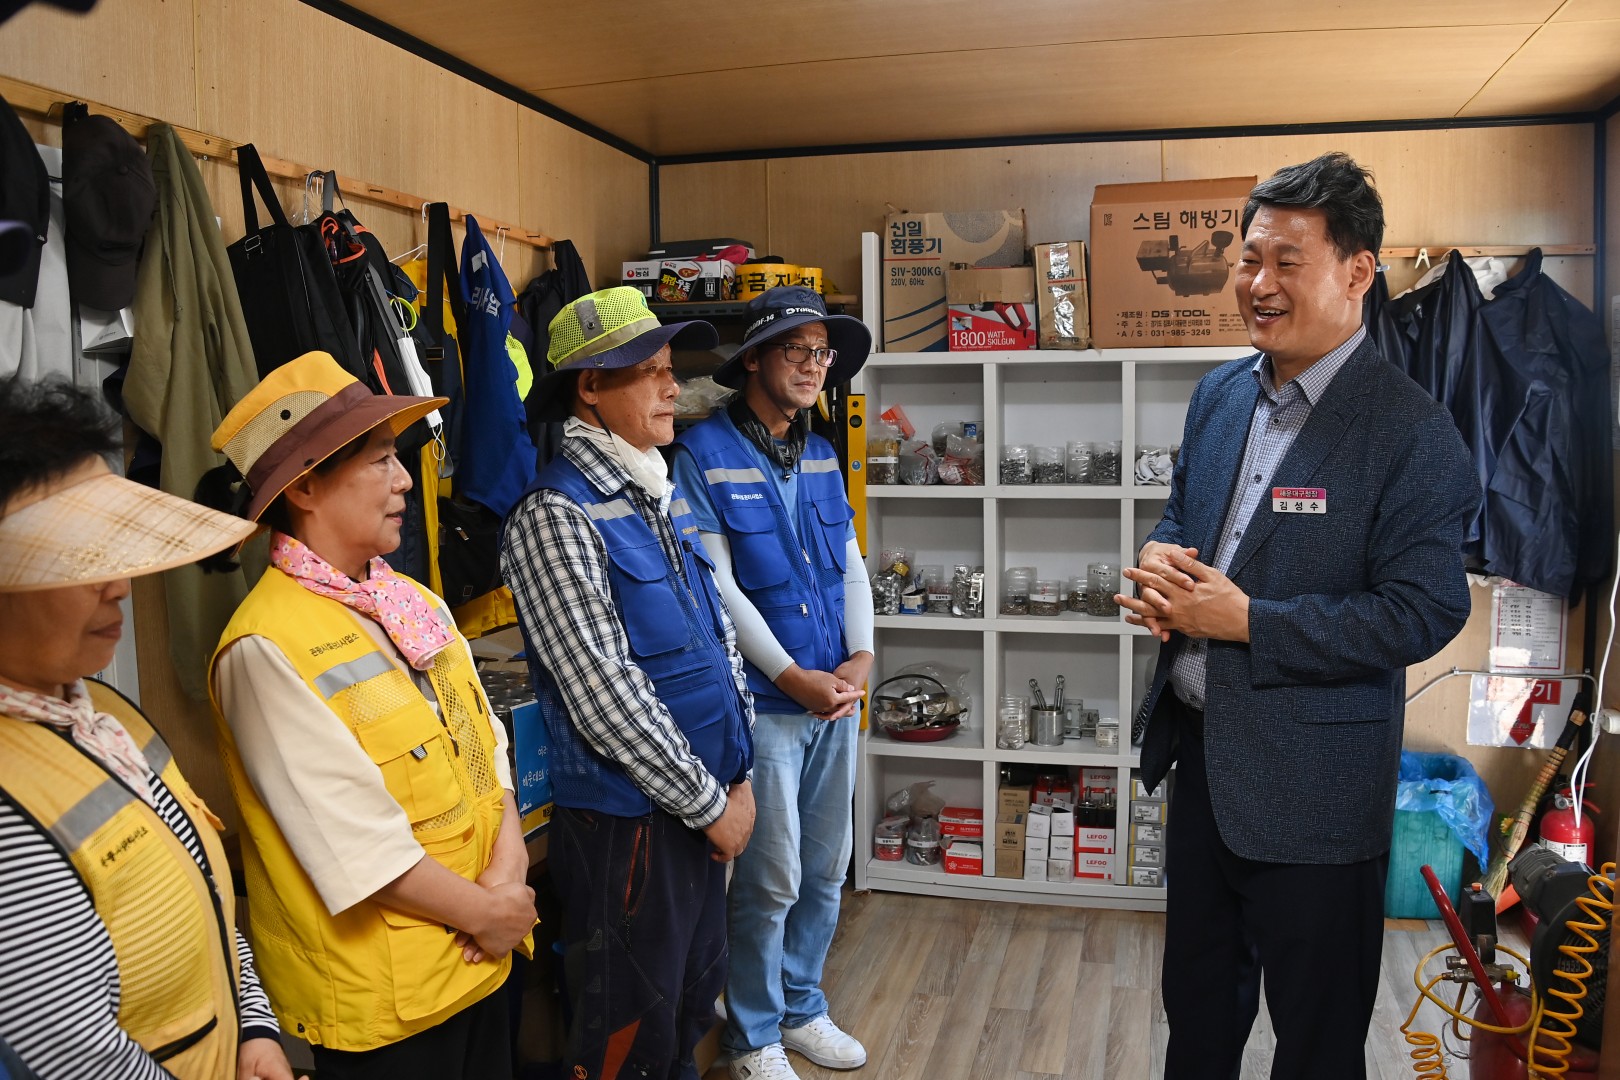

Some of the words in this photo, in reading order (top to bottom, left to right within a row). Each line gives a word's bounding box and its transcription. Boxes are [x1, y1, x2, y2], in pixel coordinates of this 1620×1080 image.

[1132, 211, 1170, 230] 스팀
[1180, 209, 1239, 229] 해빙기
[890, 221, 922, 237] 신일
[890, 238, 942, 255] 환풍기
[891, 266, 942, 277] SIV-300KG
[891, 278, 907, 287] 220V,
[909, 278, 925, 286] 60Hz
[1121, 310, 1143, 319] 제조원
[1151, 310, 1170, 318] DS
[1173, 309, 1211, 318] TOOL
[952, 331, 986, 346] 1800
[987, 330, 1006, 339] WATT
[1150, 328, 1211, 337] 031-985-3249
